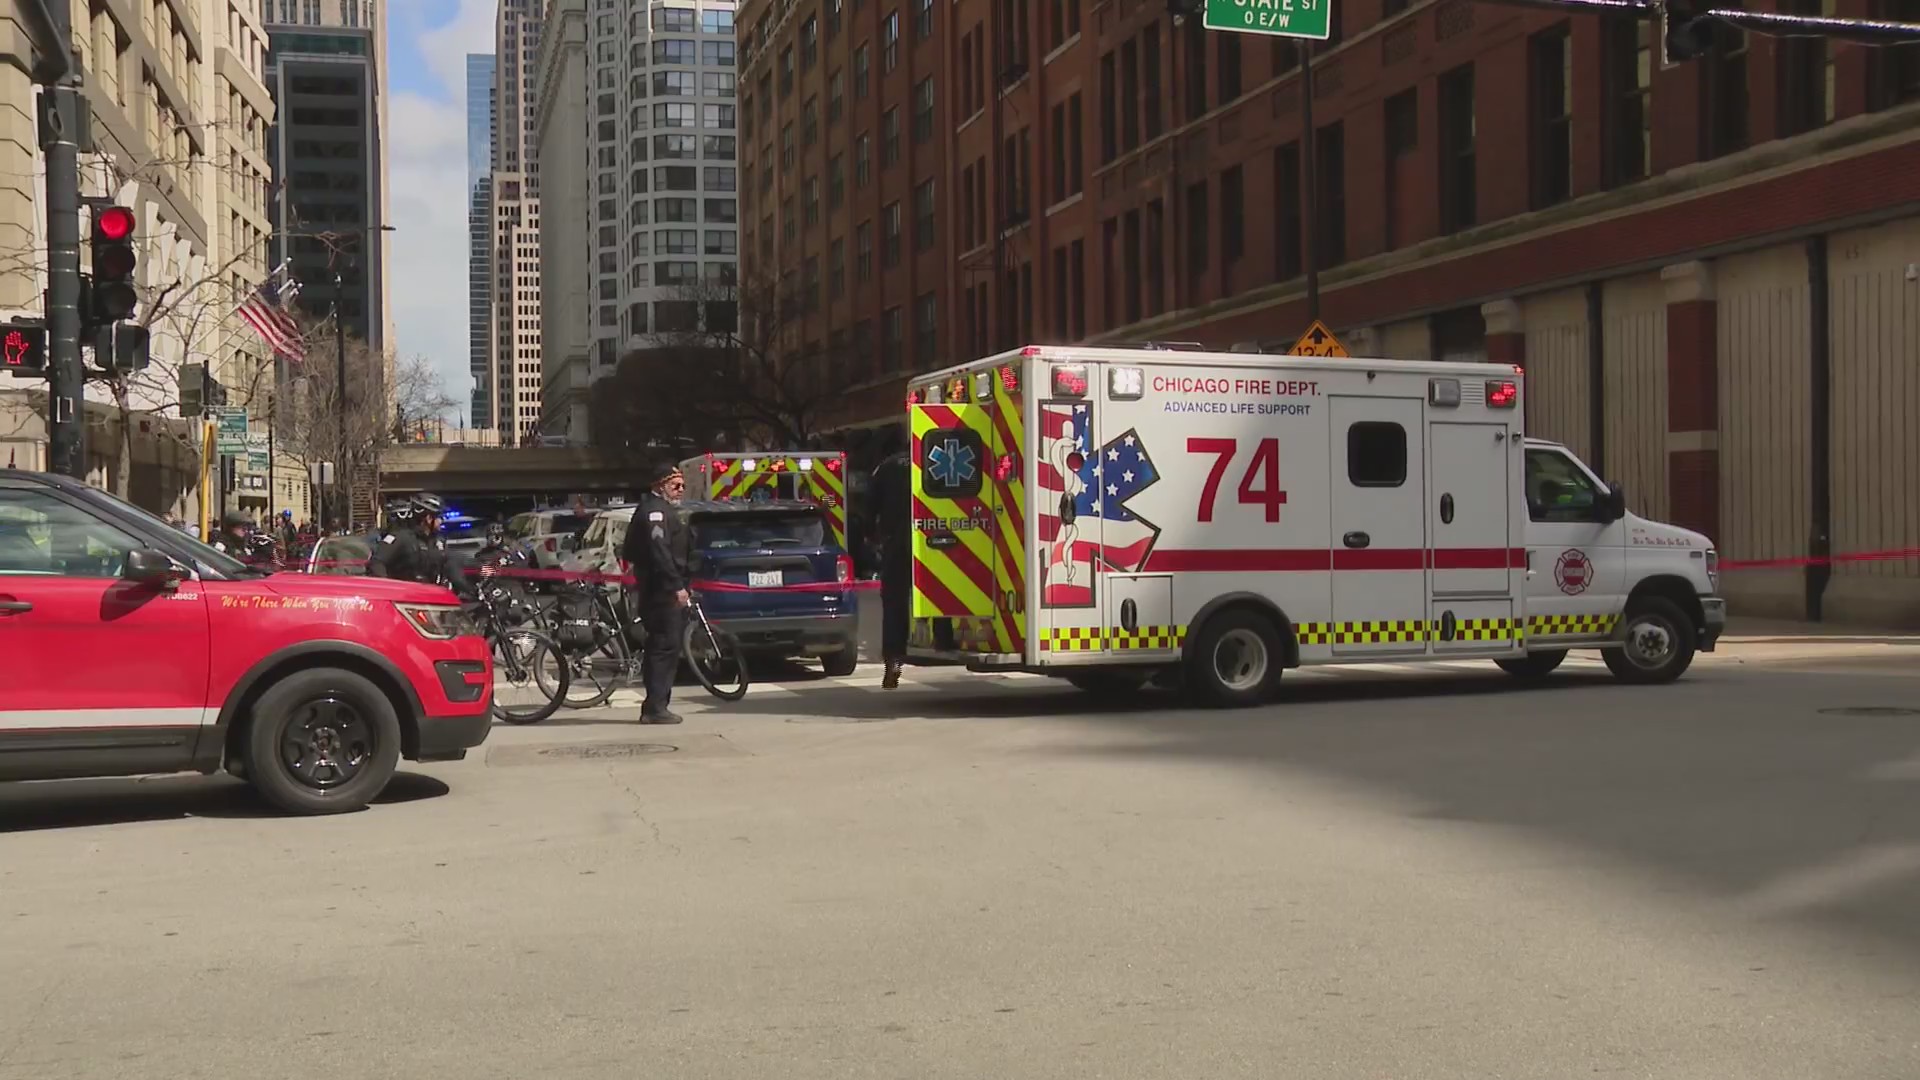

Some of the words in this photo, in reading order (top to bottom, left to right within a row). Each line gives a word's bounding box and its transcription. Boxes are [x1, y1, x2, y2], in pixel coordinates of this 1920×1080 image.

[1259, 12, 1290, 28] E/W
[1153, 376, 1230, 394] CHICAGO
[1235, 379, 1271, 395] FIRE
[1276, 381, 1321, 396] DEPT.
[1164, 401, 1227, 414] ADVANCED
[1230, 403, 1256, 415] LIFE
[1257, 404, 1311, 416] SUPPORT
[1186, 437, 1288, 523] 74
[914, 518, 947, 530] FIRE
[951, 518, 991, 531] DEPT.
[221, 595, 249, 609] We're
[252, 596, 279, 609] There
[282, 596, 307, 610] When
[563, 619, 589, 627] POLICE
